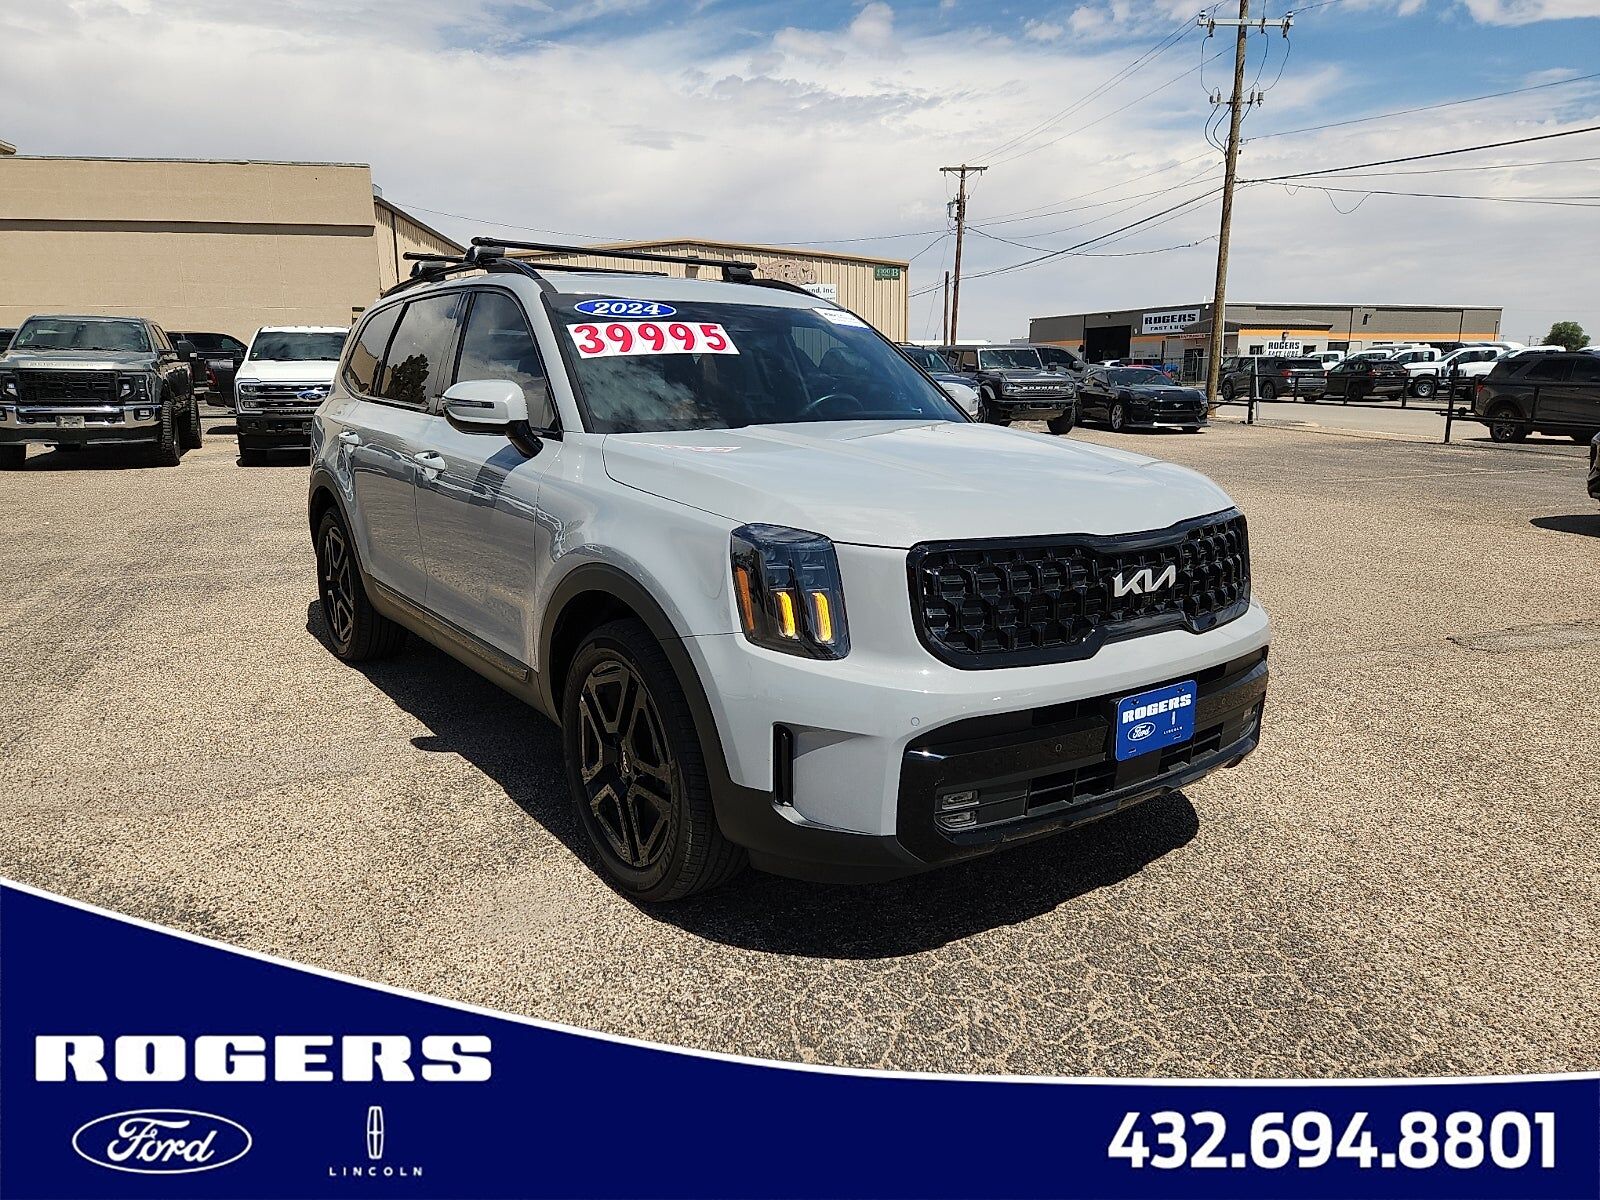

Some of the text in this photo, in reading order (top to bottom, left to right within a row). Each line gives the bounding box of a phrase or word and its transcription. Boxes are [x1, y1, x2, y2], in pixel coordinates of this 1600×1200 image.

[892, 268, 899, 277] B
[593, 302, 661, 316] 2024
[1144, 313, 1197, 325] ROGERS
[574, 323, 727, 354] 39995
[1267, 341, 1300, 350] ROGERS
[1112, 564, 1176, 598] KIA
[1122, 694, 1192, 724] ROGERS
[1132, 724, 1151, 739] Ford
